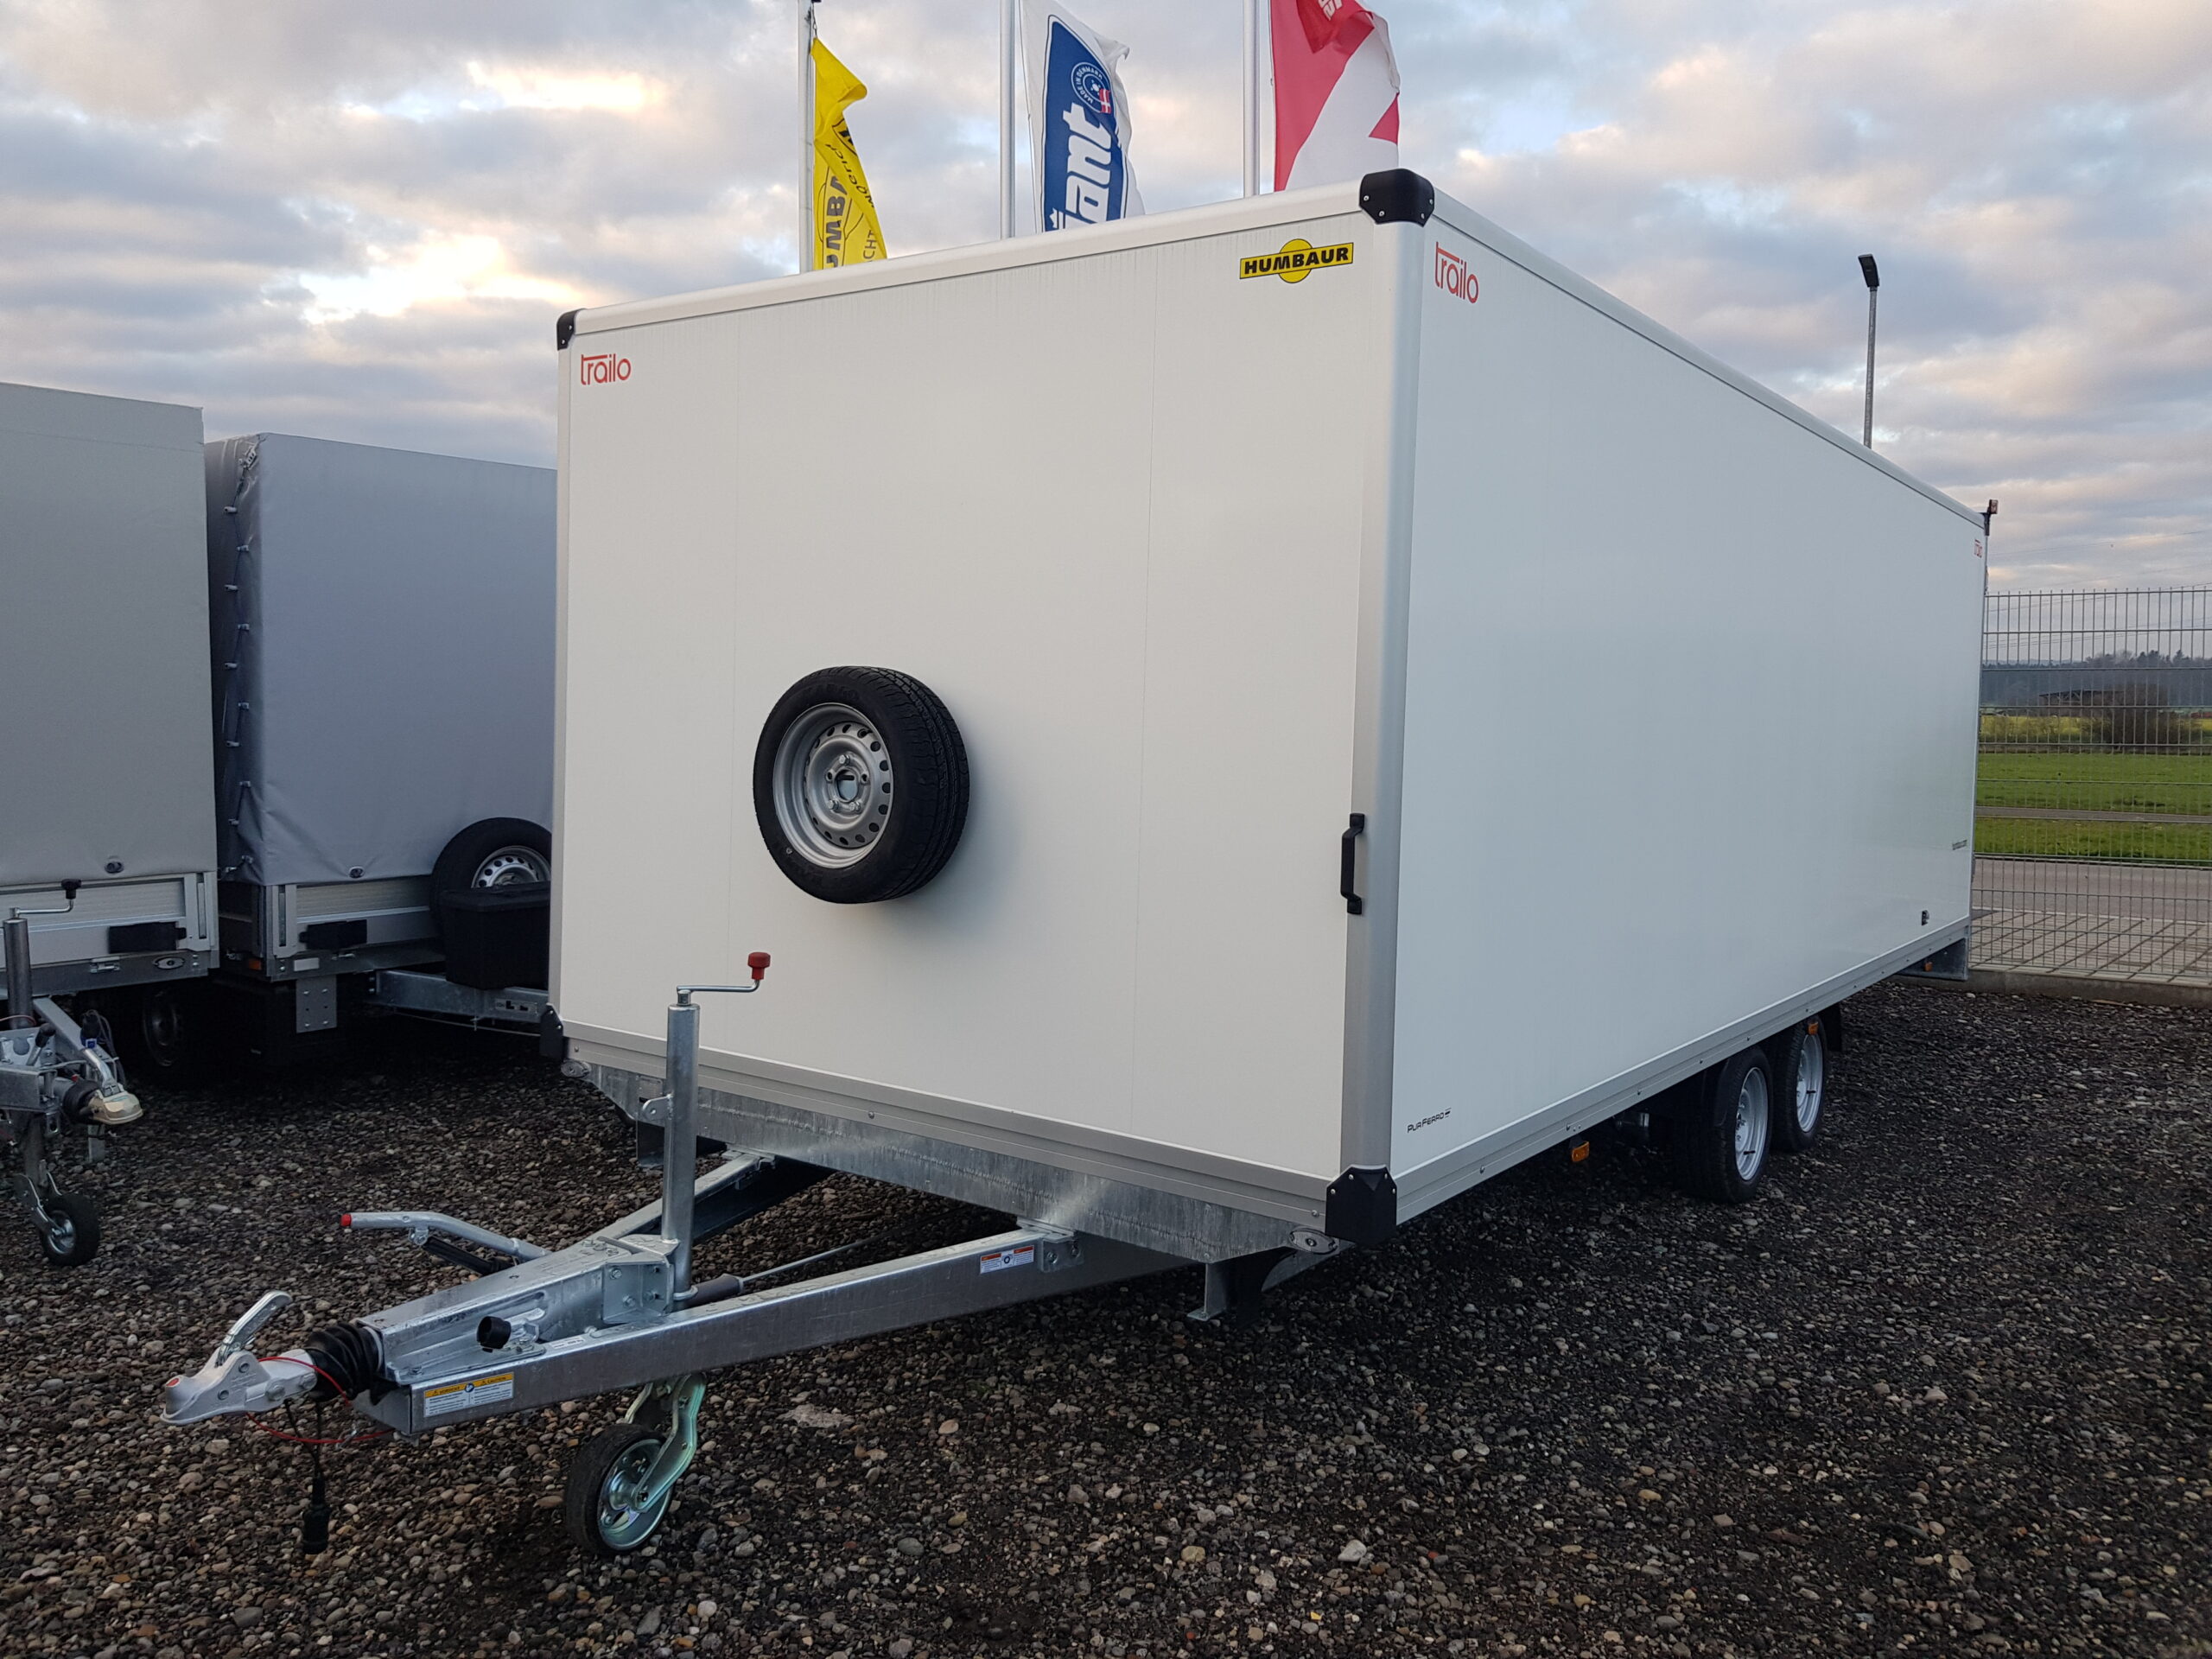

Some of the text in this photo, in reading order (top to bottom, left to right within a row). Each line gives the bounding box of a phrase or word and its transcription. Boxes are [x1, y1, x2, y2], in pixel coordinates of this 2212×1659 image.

[1244, 247, 1349, 274] HUMBAUR
[1435, 241, 1478, 303] trailo
[581, 353, 632, 385] trailo
